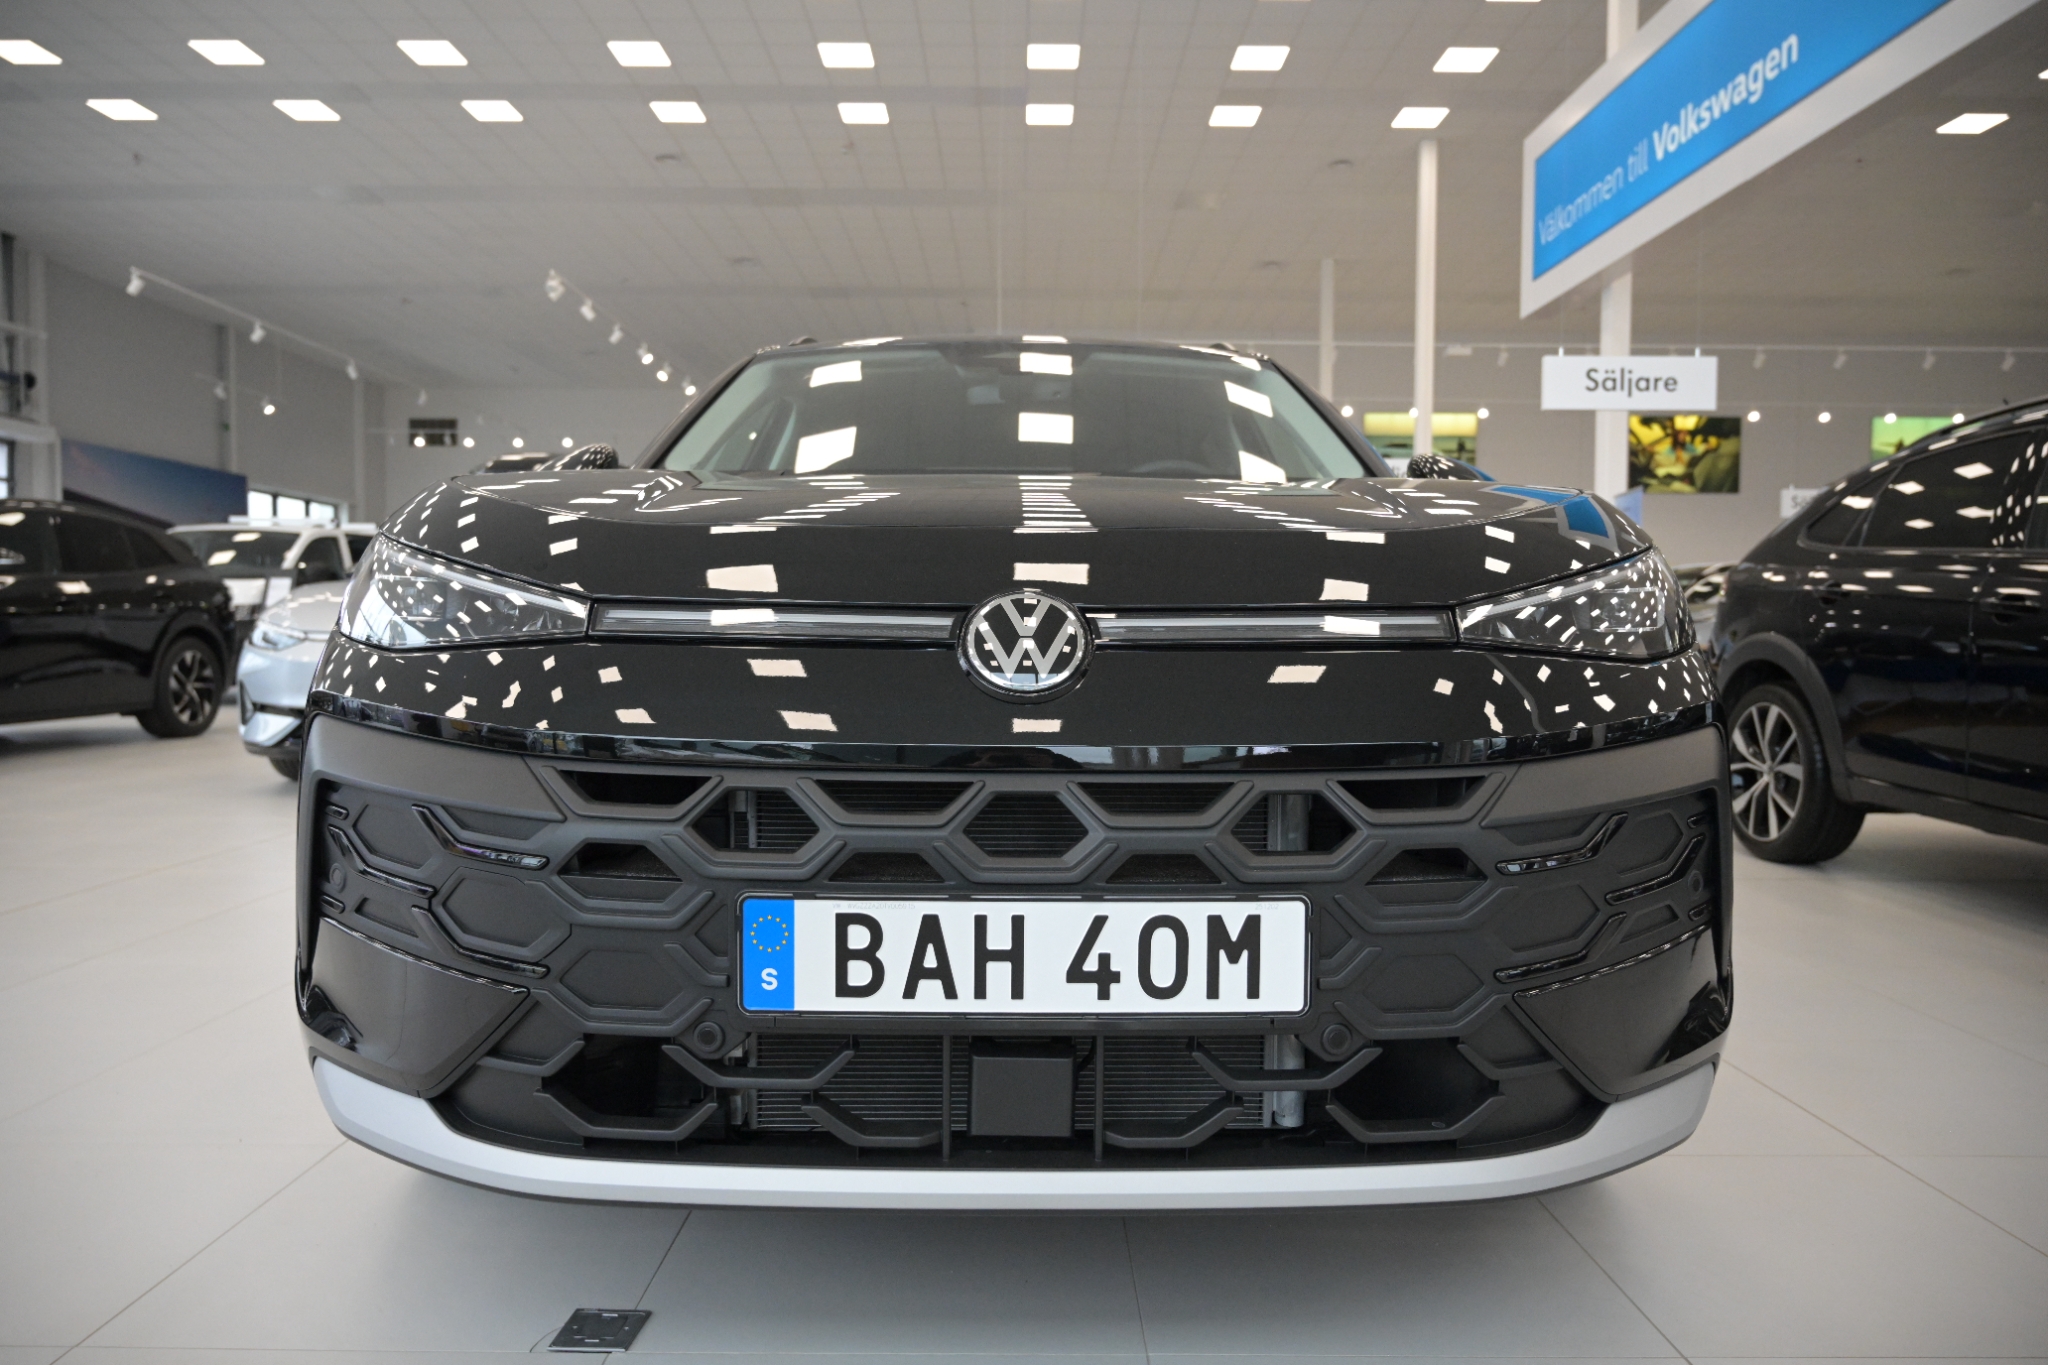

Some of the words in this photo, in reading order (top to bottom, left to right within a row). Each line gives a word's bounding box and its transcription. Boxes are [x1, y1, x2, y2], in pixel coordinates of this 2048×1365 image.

[1538, 166, 1624, 245] Välkommen
[1627, 138, 1649, 182] till
[1653, 34, 1799, 161] Volkswagen
[1585, 367, 1678, 398] Säljare
[970, 594, 1080, 686] VW
[761, 968, 778, 990] S
[835, 912, 1024, 1000] BAH
[1066, 914, 1261, 1000] 40M
